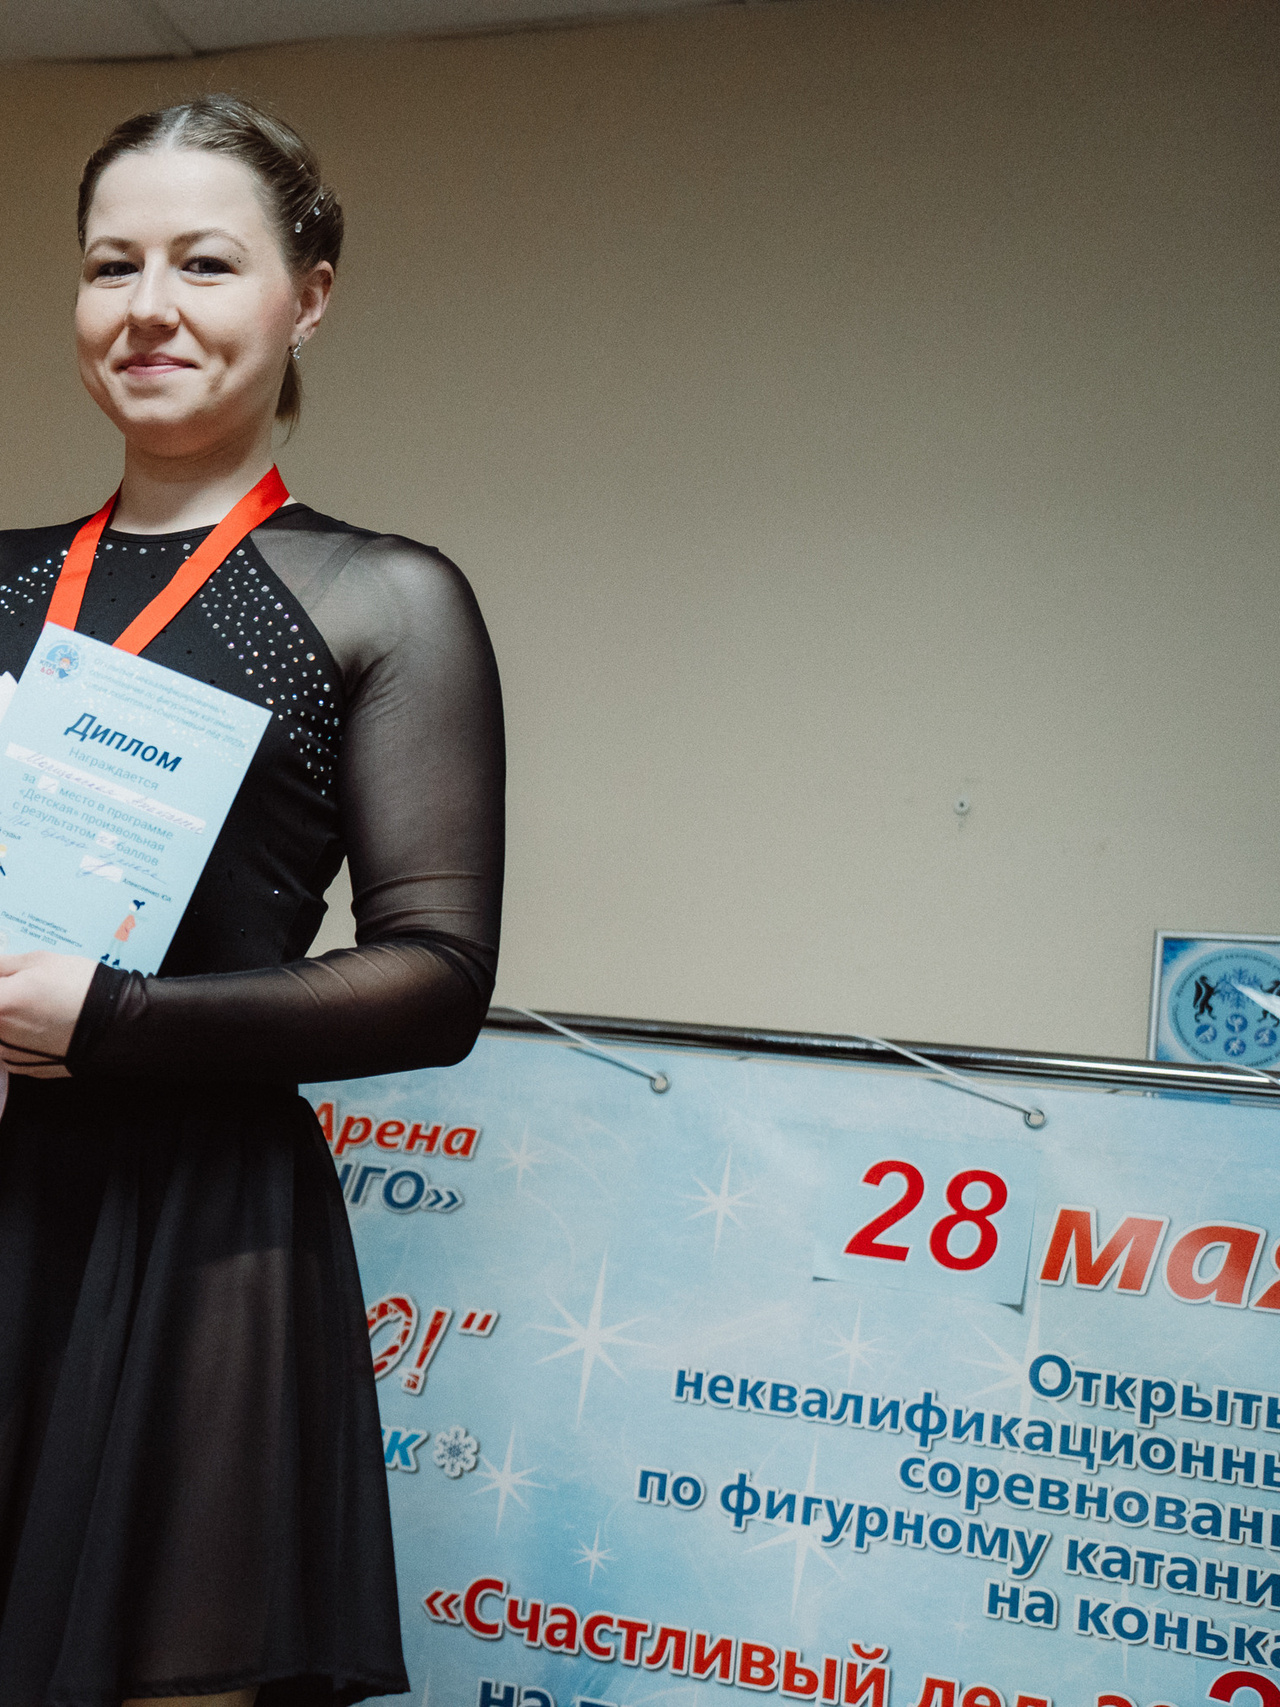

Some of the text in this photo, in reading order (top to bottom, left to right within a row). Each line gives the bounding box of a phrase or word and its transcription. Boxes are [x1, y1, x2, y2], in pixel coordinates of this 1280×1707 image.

[64, 712, 183, 773] Диплом
[69, 746, 160, 791] Награждается
[20, 805, 96, 840] результатом
[116, 842, 159, 866] баллов
[22, 773, 36, 785] за
[59, 788, 95, 808] место
[107, 807, 174, 840] программе
[81, 809, 166, 853] произвольная
[844, 1160, 1008, 1271] 28
[1029, 1354, 1280, 1430] Открыт
[638, 1470, 702, 1506] по
[720, 1472, 1048, 1574] фигурному
[899, 1457, 1280, 1548] соревнован
[987, 1582, 1056, 1626] на
[425, 1578, 886, 1707] «Счастливый
